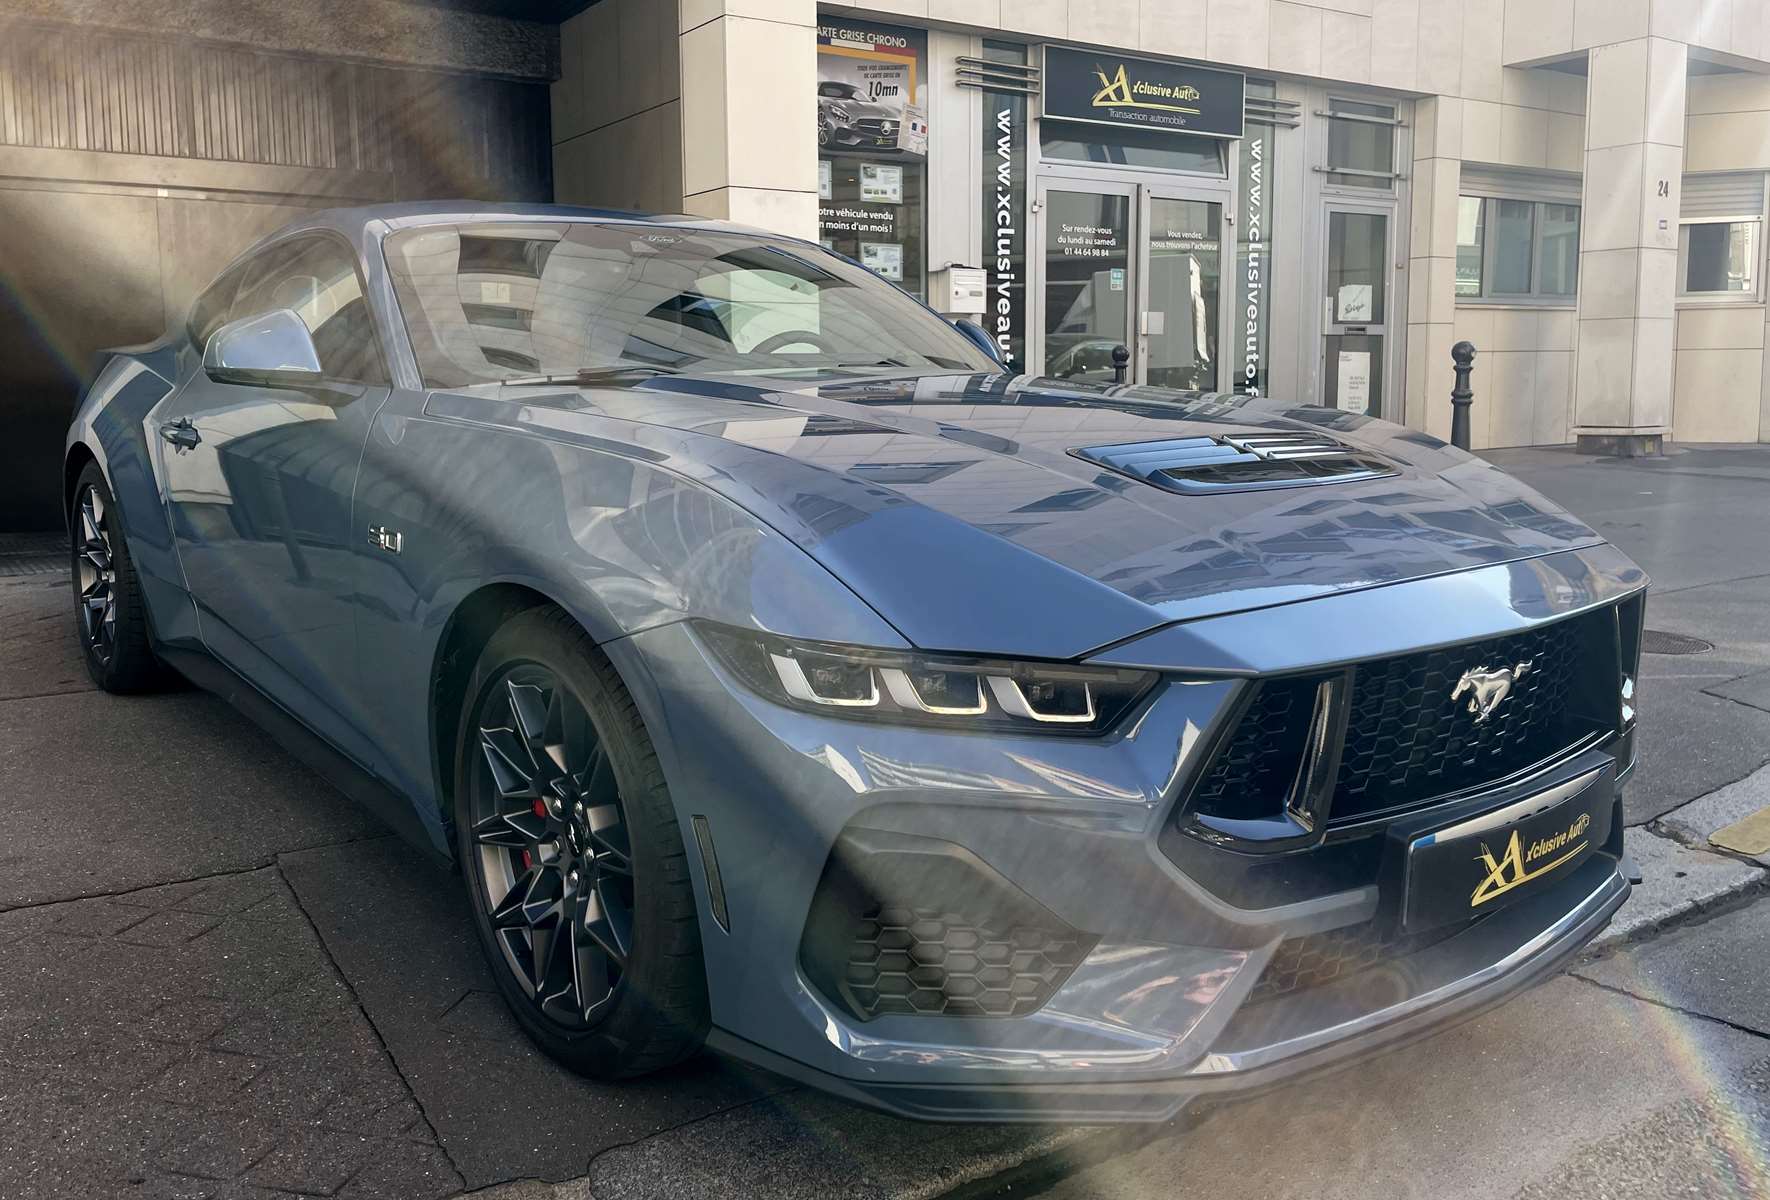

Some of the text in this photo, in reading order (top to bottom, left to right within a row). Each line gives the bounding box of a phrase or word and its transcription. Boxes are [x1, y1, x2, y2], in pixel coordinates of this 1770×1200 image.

[839, 29, 865, 43] GRISE
[867, 33, 906, 48] CHRONO
[869, 80, 898, 97] 10mn
[1108, 108, 1187, 126] Transaction automobile
[1658, 180, 1669, 198] 24
[836, 207, 869, 219] véhicule
[869, 211, 894, 221] vendu
[826, 221, 850, 230] moins
[851, 221, 869, 231] d'un
[1062, 224, 1113, 235] Sur rendez-vous
[1167, 230, 1180, 238] Vous
[1057, 235, 1067, 243] du
[1067, 235, 1083, 244] lundi
[1094, 238, 1117, 247] samedi
[1064, 247, 1072, 255] 01
[1074, 248, 1082, 256] 44
[1083, 248, 1091, 256] 64
